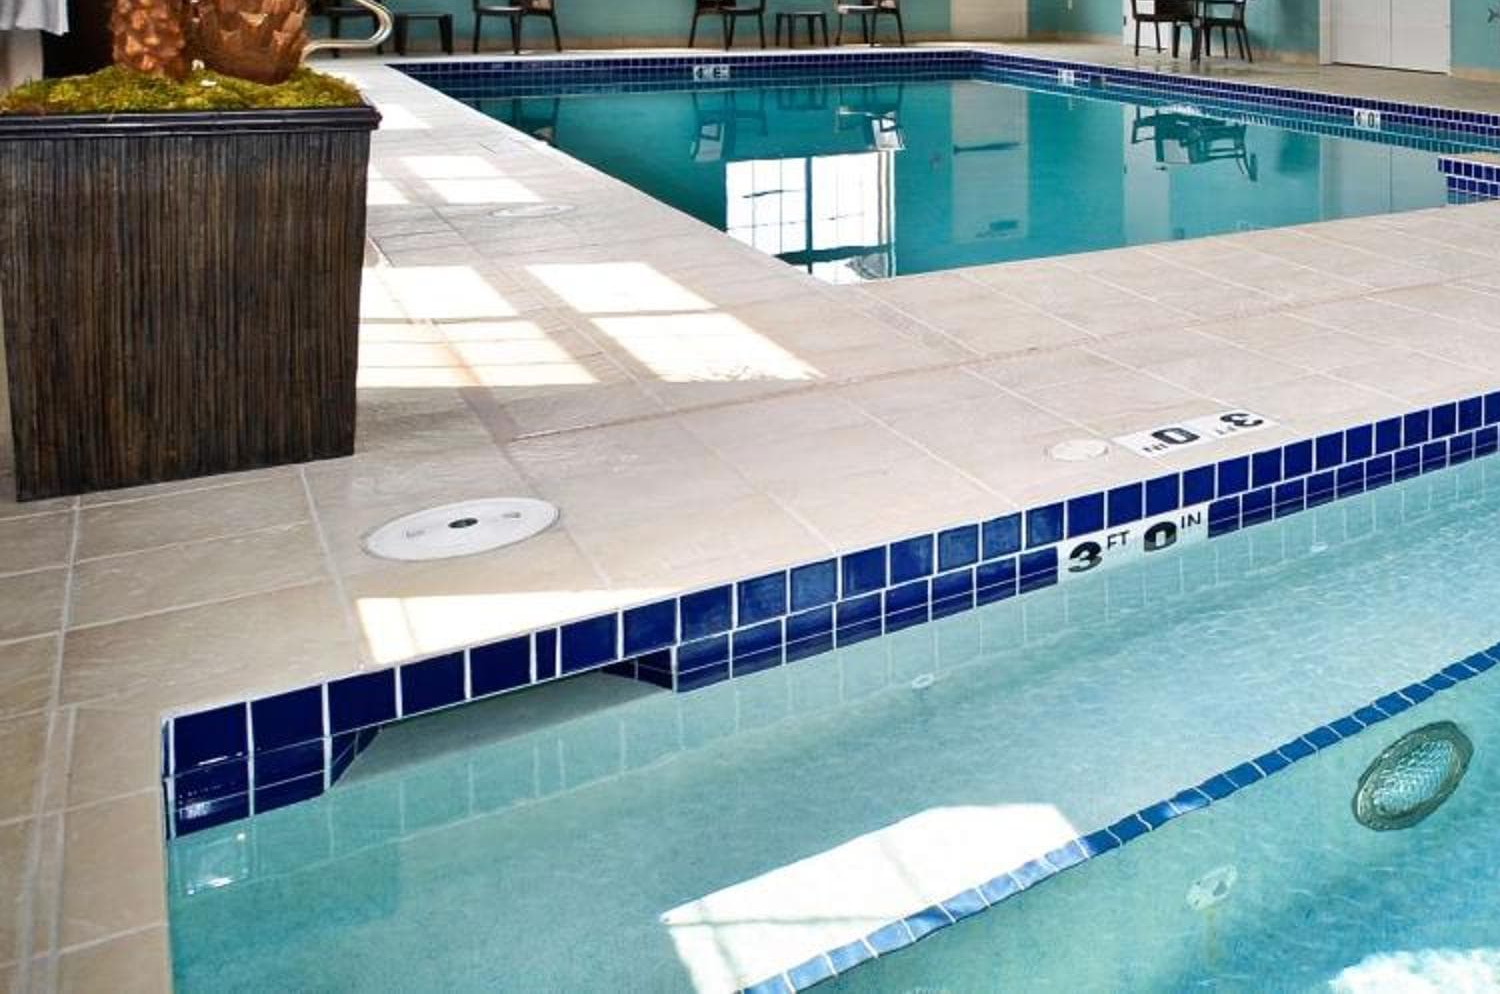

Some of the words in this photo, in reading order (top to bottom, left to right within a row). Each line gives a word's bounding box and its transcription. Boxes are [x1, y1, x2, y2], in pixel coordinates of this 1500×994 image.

[1068, 541, 1103, 573] 3
[1107, 529, 1130, 551] FT
[1143, 520, 1178, 552] 0
[1180, 511, 1202, 530] IN
